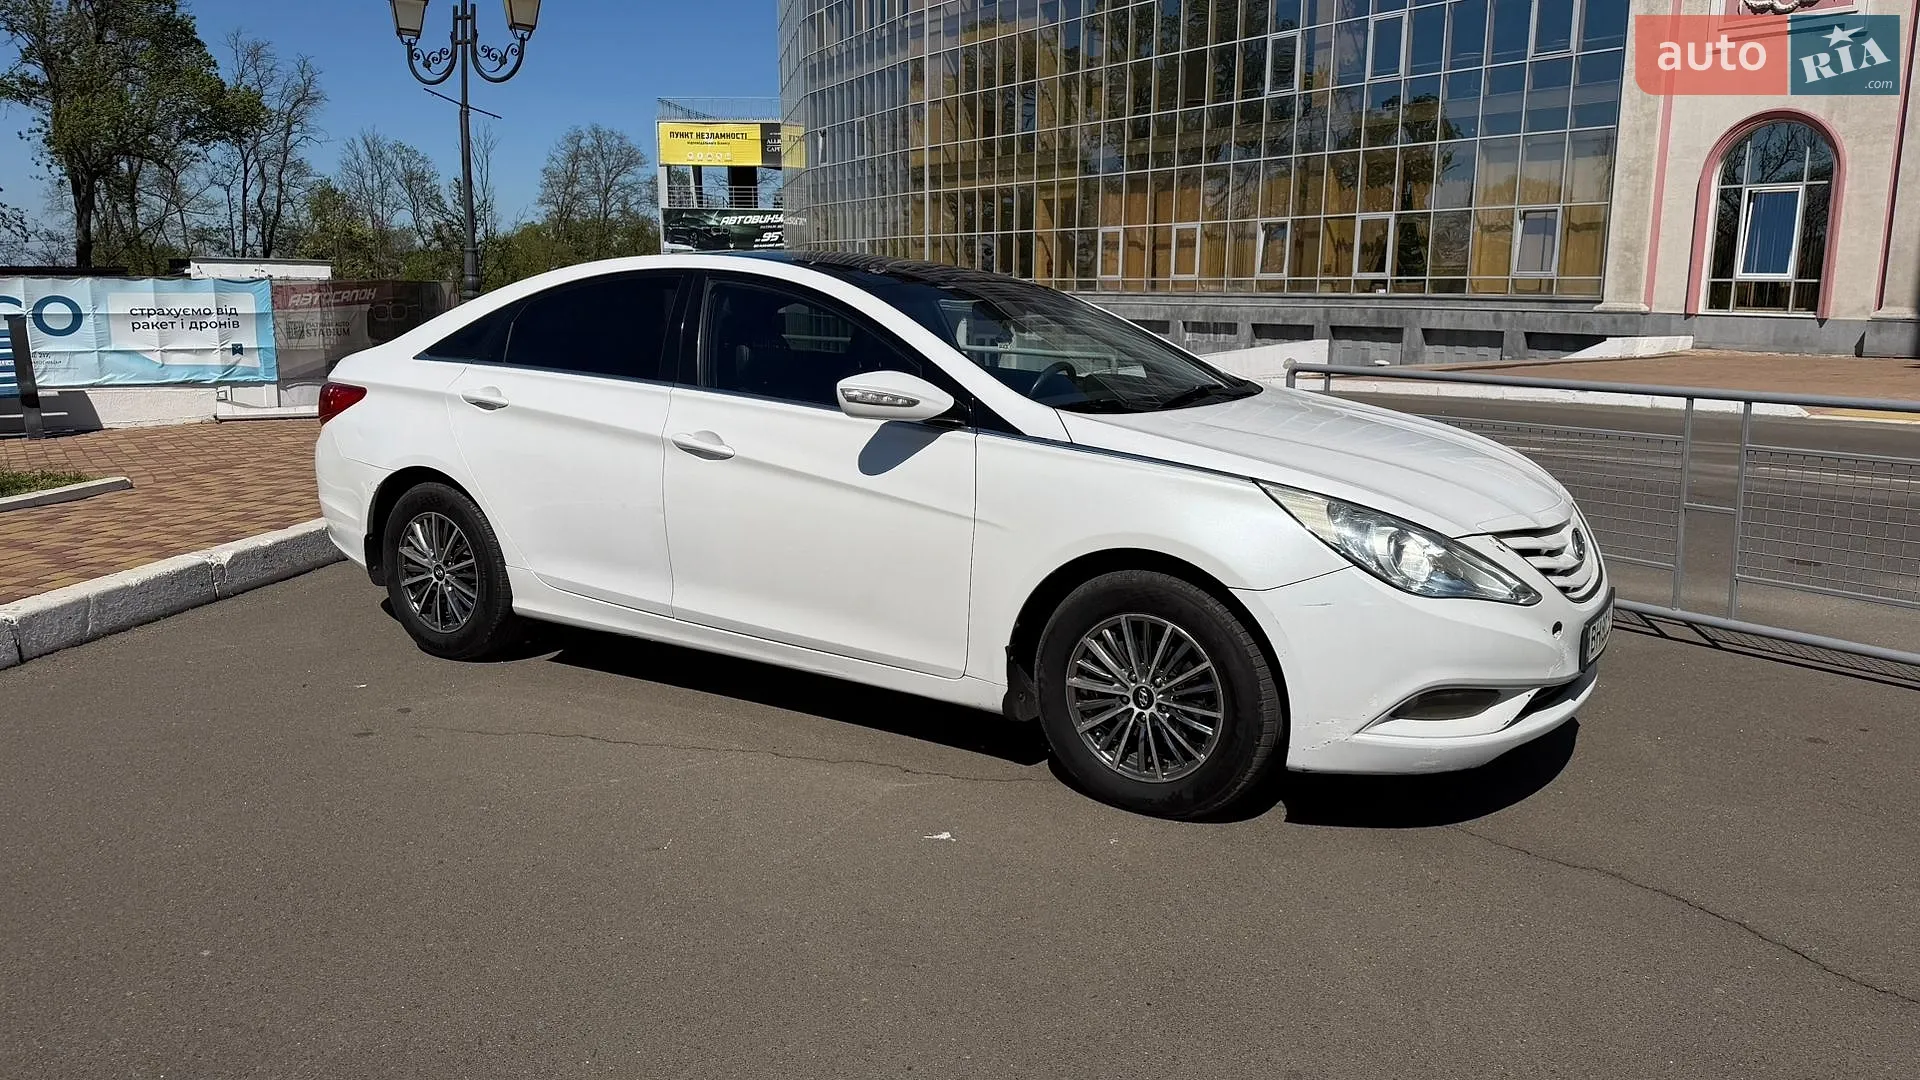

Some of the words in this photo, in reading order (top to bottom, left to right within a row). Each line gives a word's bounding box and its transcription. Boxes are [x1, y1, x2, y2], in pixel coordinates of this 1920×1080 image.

[669, 131, 694, 140] ПУНКТ
[695, 131, 748, 141] НЕЗЛАМНОСТІ
[129, 307, 212, 318] страхуємо
[216, 304, 239, 317] від
[131, 320, 177, 332] ракет
[180, 318, 185, 329] і
[188, 317, 240, 331] дронів
[305, 327, 351, 338] STADIUM
